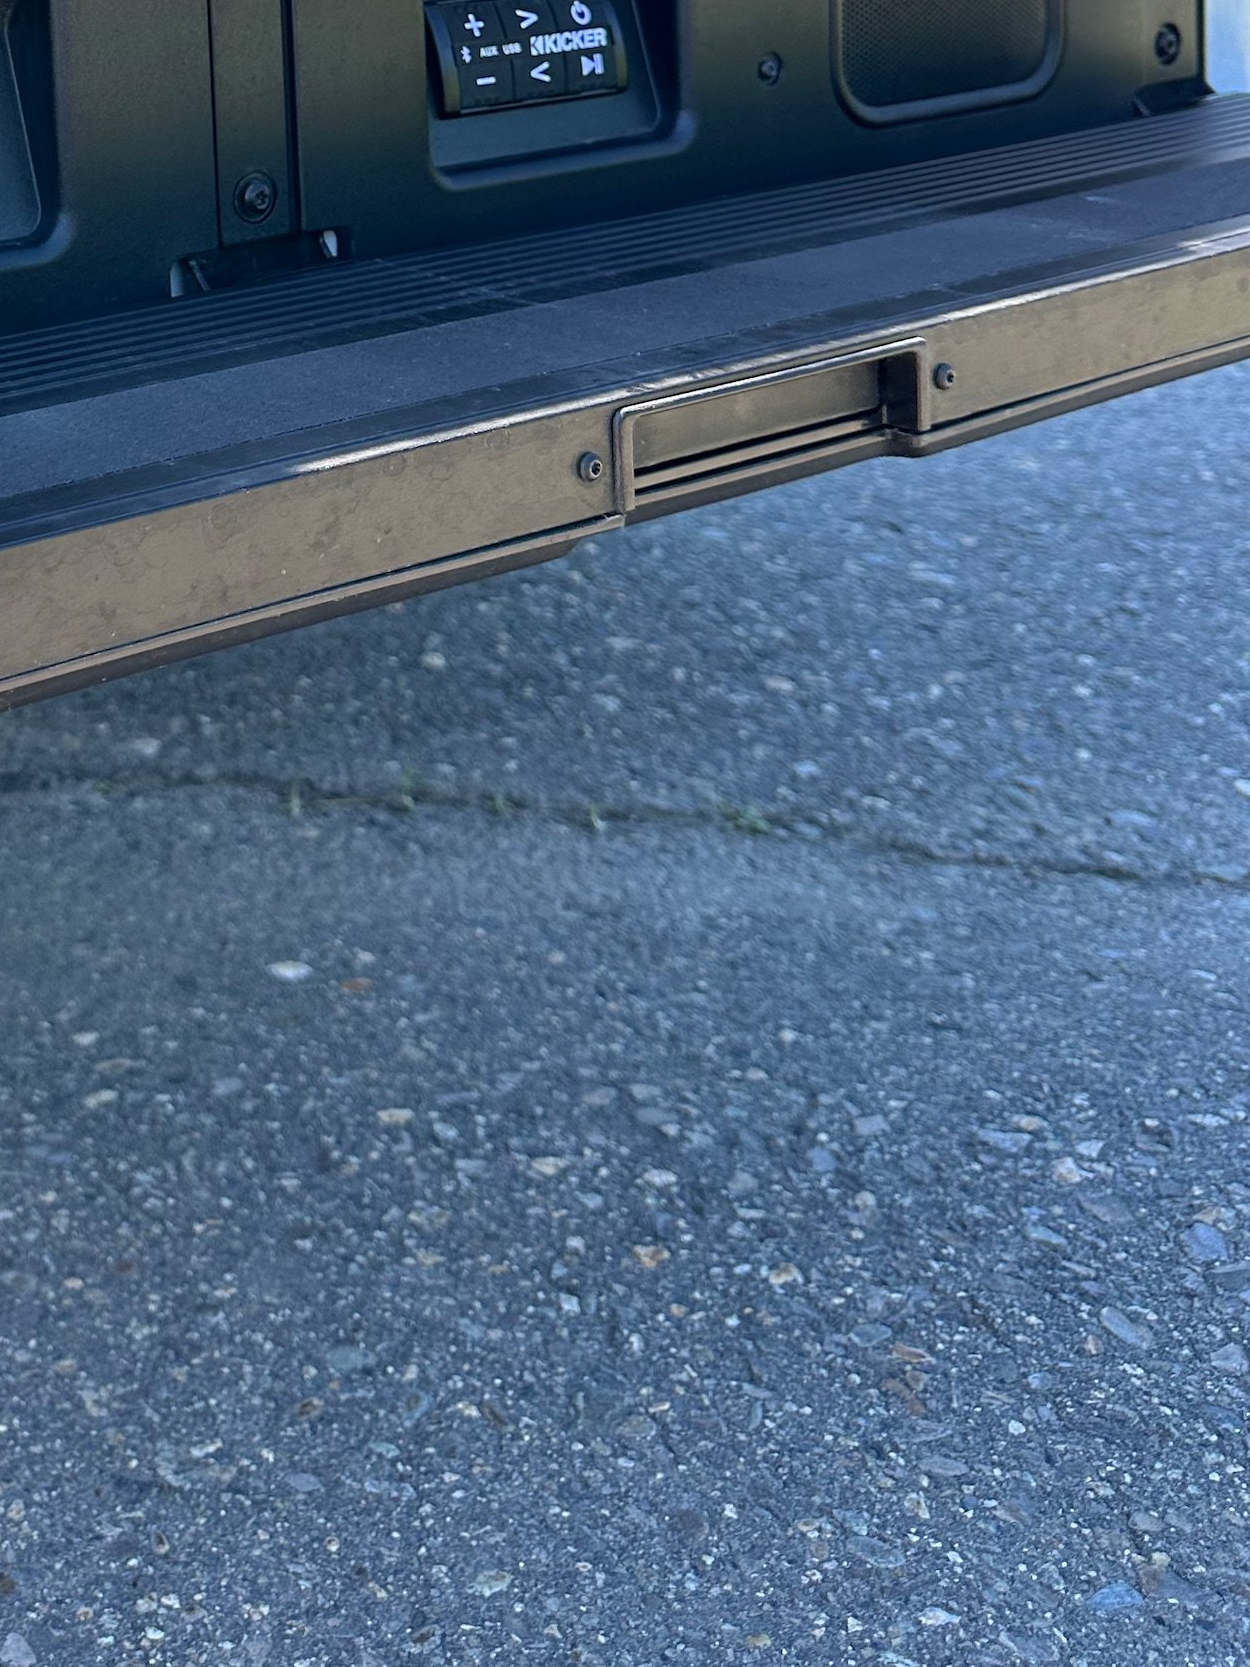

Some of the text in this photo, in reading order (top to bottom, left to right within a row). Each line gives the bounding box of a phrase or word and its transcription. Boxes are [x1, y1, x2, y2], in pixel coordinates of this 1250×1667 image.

[479, 42, 523, 59] AUX USB
[545, 26, 608, 55] KICKER
